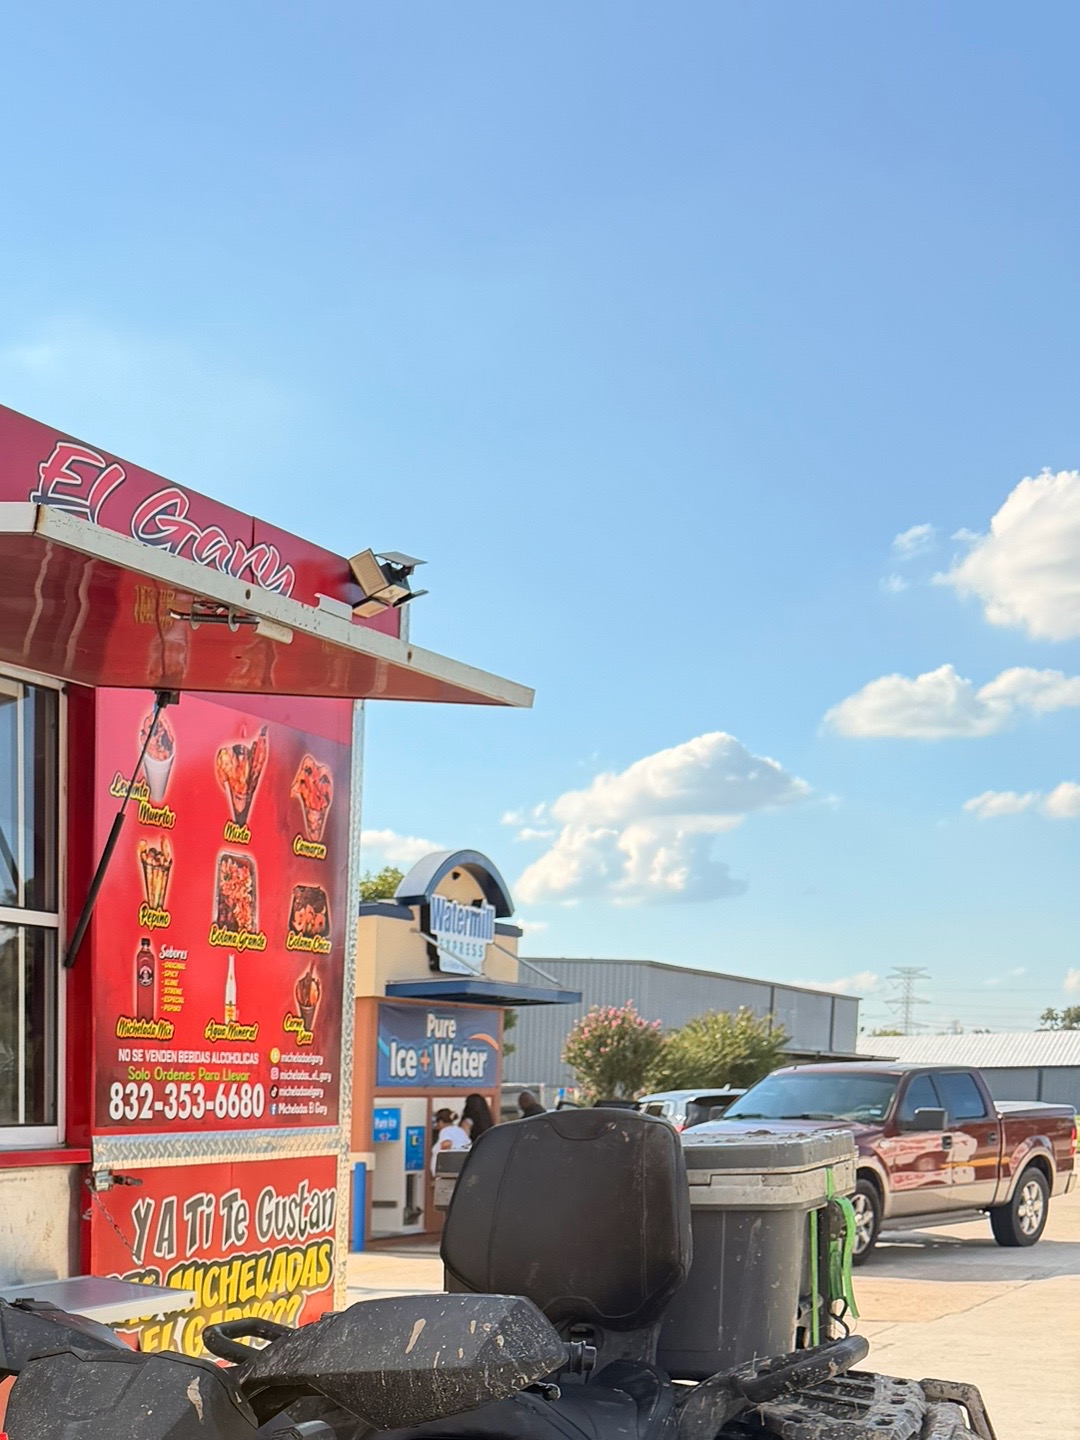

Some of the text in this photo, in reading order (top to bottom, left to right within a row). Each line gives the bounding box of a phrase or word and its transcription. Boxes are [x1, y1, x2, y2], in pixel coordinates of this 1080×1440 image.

[30, 441, 126, 524] El
[131, 487, 295, 597] Gary
[139, 802, 176, 827] Muertos
[225, 823, 251, 843] Mixta
[139, 904, 170, 930] Pepino
[430, 895, 494, 941] Watermill
[210, 924, 266, 951] Botana Grande
[286, 931, 312, 950] Botana
[159, 944, 188, 960] Sabores
[117, 1015, 157, 1038] Michelada
[205, 1019, 258, 1041] Agua Mineral
[426, 1012, 457, 1039] Pure
[118, 1048, 259, 1065] NO SE VENDEN BEBIDAS ALCOHOLICAS
[390, 1042, 417, 1077] Ice
[433, 1043, 487, 1078] Water
[127, 1065, 250, 1082] Solo Ordenes Para Llevar
[109, 1082, 265, 1120] 832-353-6680
[132, 1180, 336, 1265] Y A Ti Te Gustan
